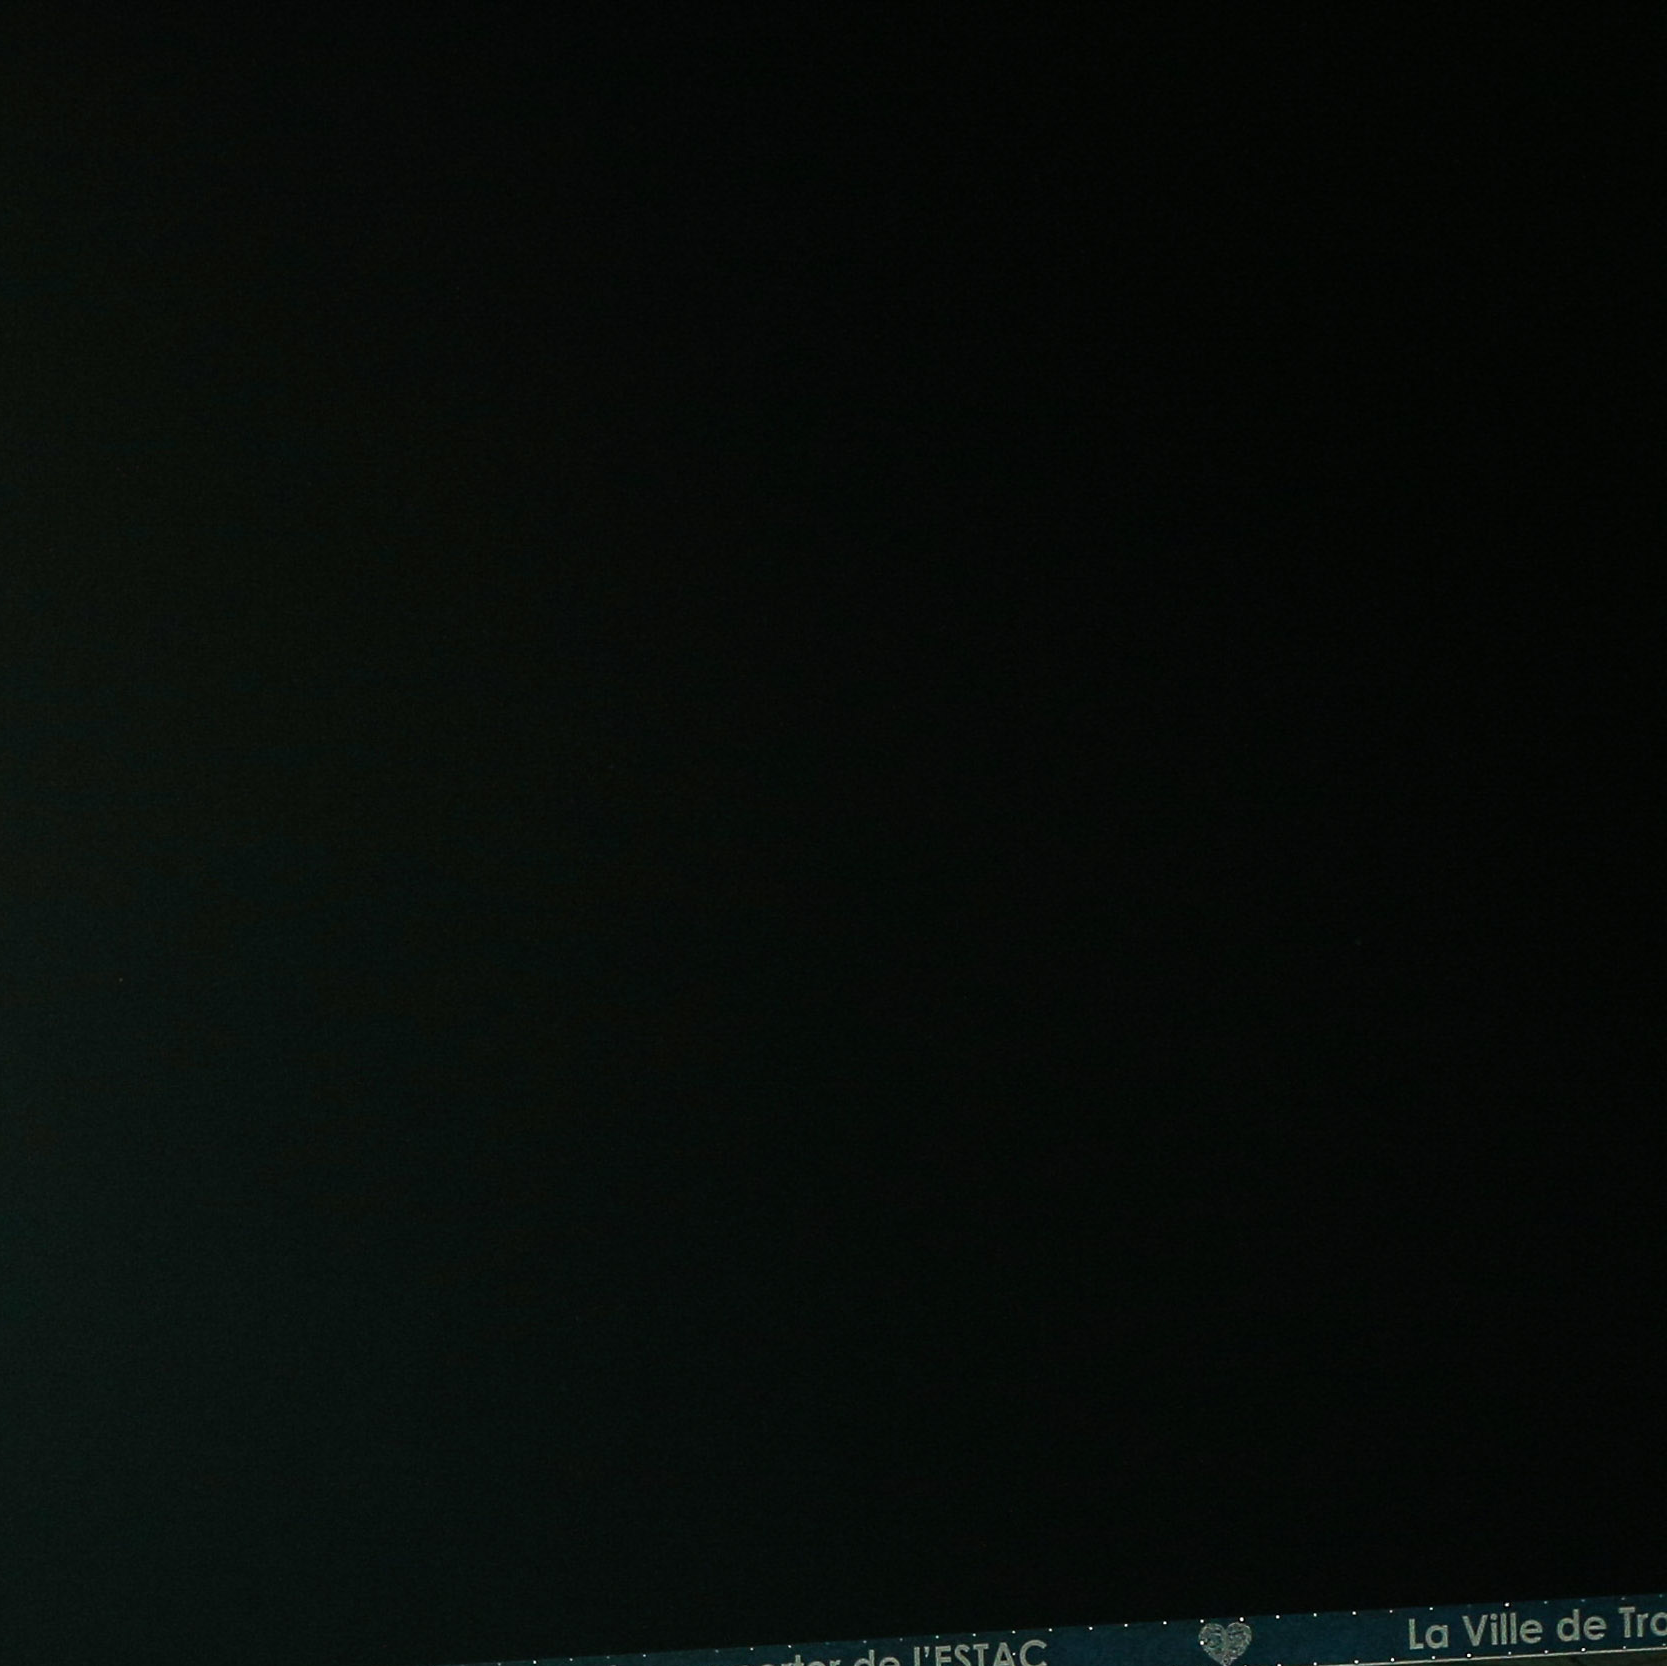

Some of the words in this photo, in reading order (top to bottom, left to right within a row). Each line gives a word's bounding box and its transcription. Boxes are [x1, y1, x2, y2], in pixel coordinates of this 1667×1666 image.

[1408, 1618, 1449, 1650] La
[1462, 1612, 1543, 1647] Ville
[1557, 1609, 1606, 1641] de
